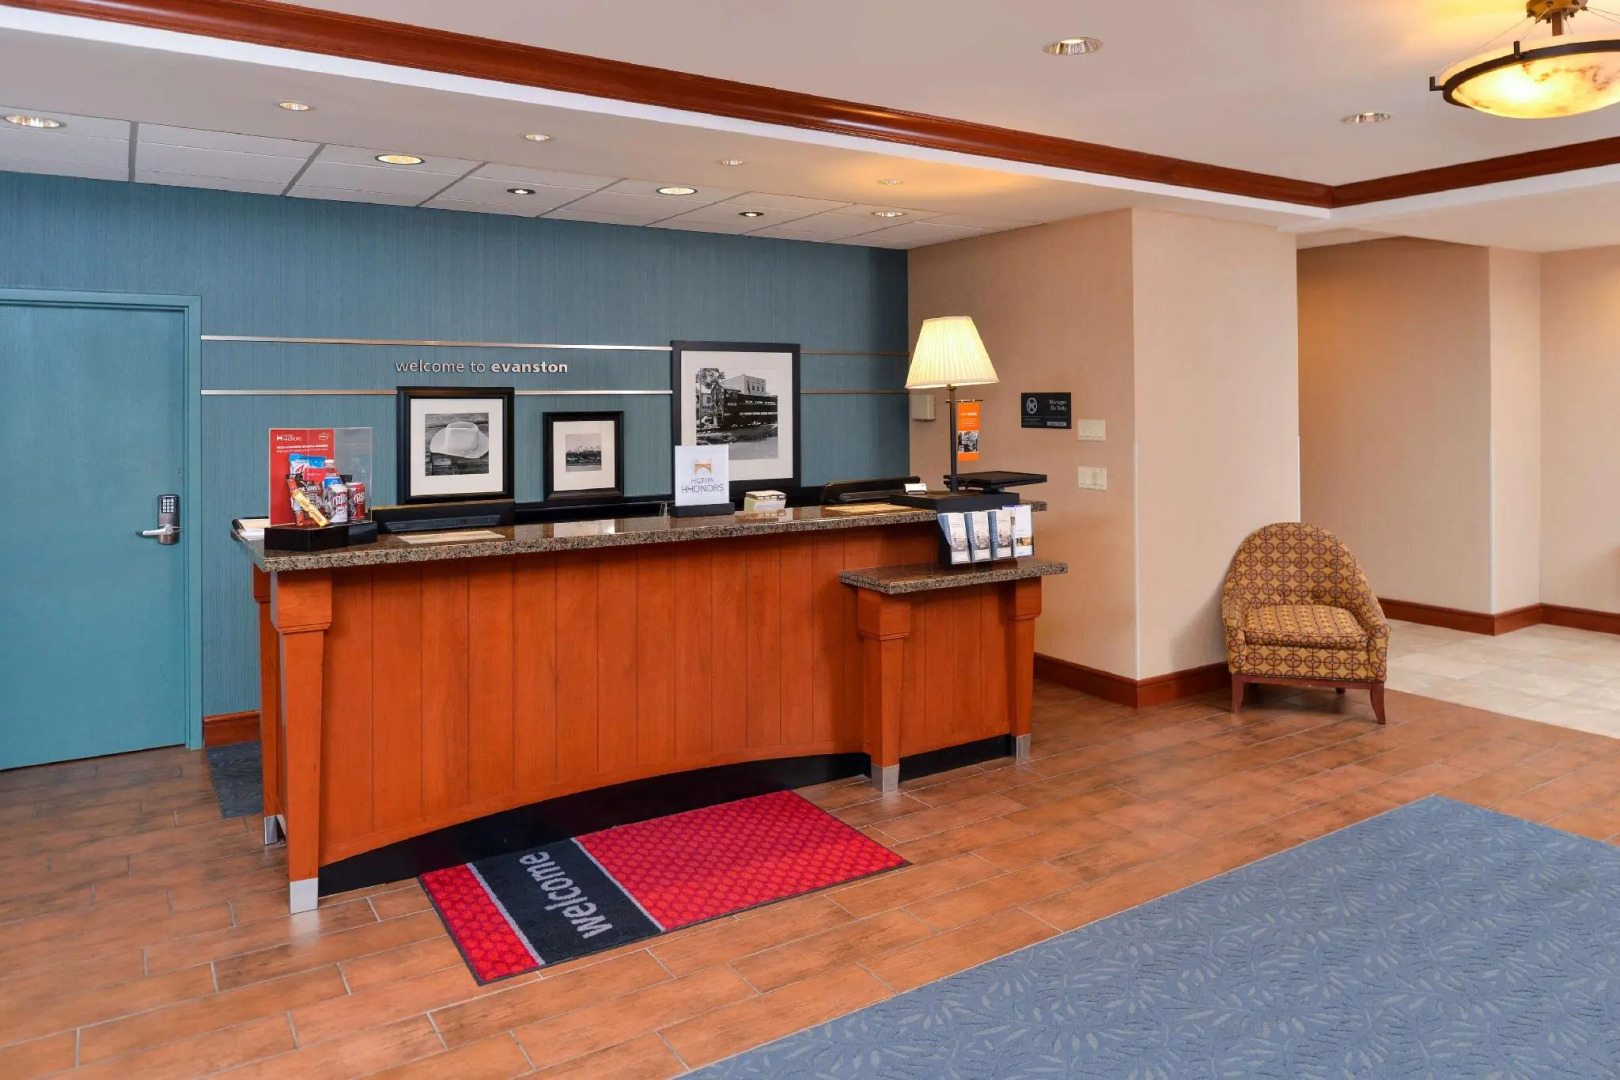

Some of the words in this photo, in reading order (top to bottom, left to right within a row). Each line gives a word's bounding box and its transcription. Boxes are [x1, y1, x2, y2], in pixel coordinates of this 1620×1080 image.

[395, 359, 464, 373] welcome
[470, 361, 485, 373] to
[491, 361, 568, 373] evanston
[519, 851, 613, 939] welcome
